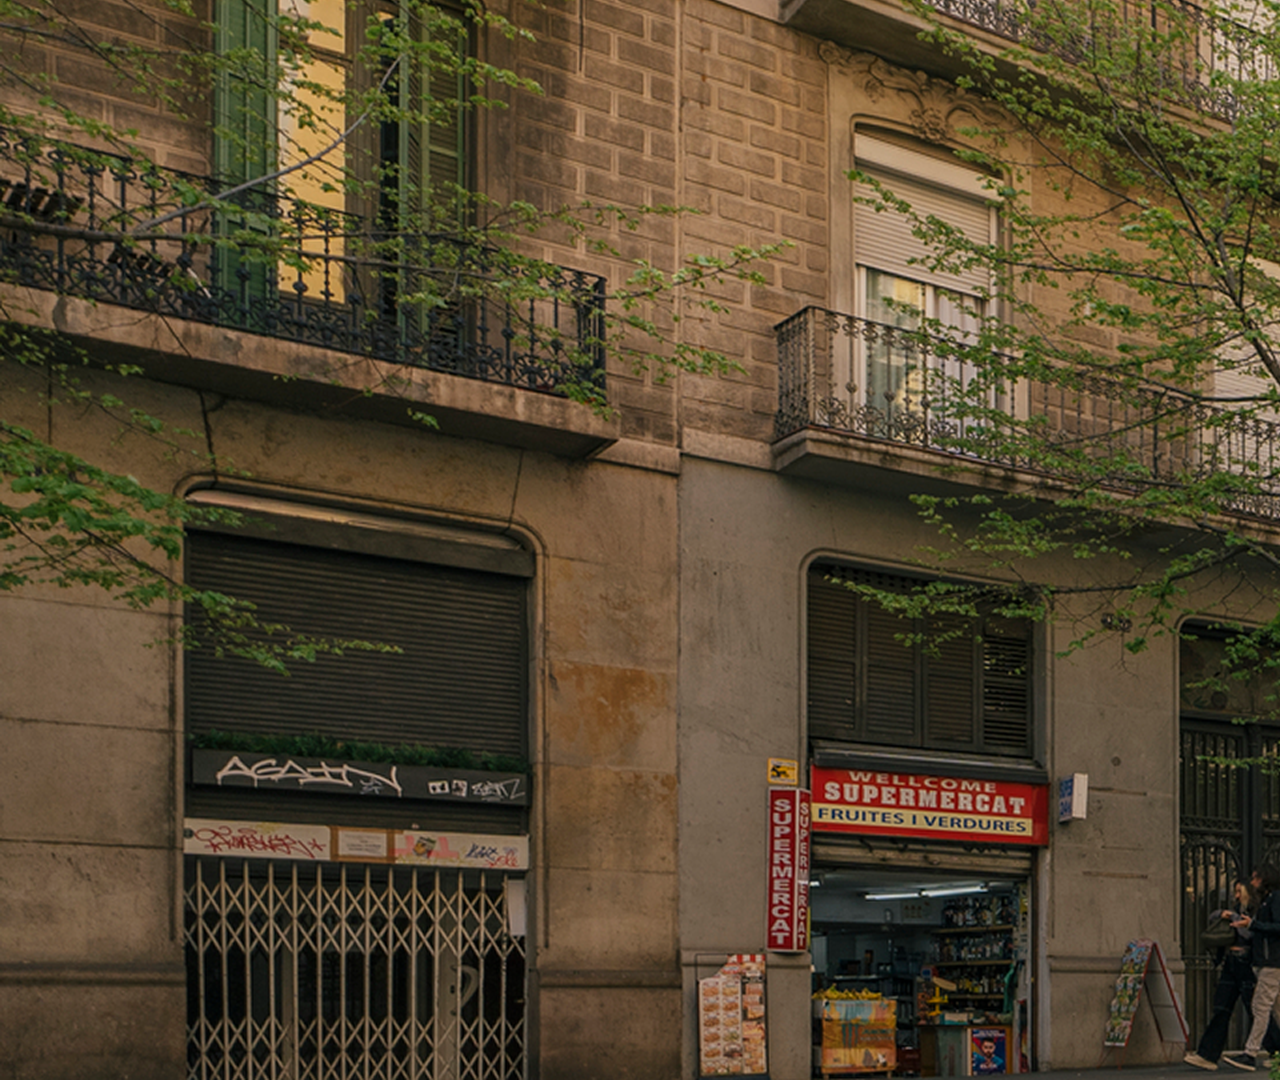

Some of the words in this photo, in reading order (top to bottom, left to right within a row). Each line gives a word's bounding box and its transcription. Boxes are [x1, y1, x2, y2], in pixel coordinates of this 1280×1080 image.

[848, 770, 997, 793] WELLCOME
[824, 781, 1026, 815] SUPERMERCAT
[817, 807, 904, 825] FRUITES
[912, 814, 918, 826] I
[923, 816, 1027, 833] VERDURES
[771, 798, 792, 945] SUPERMERCAT
